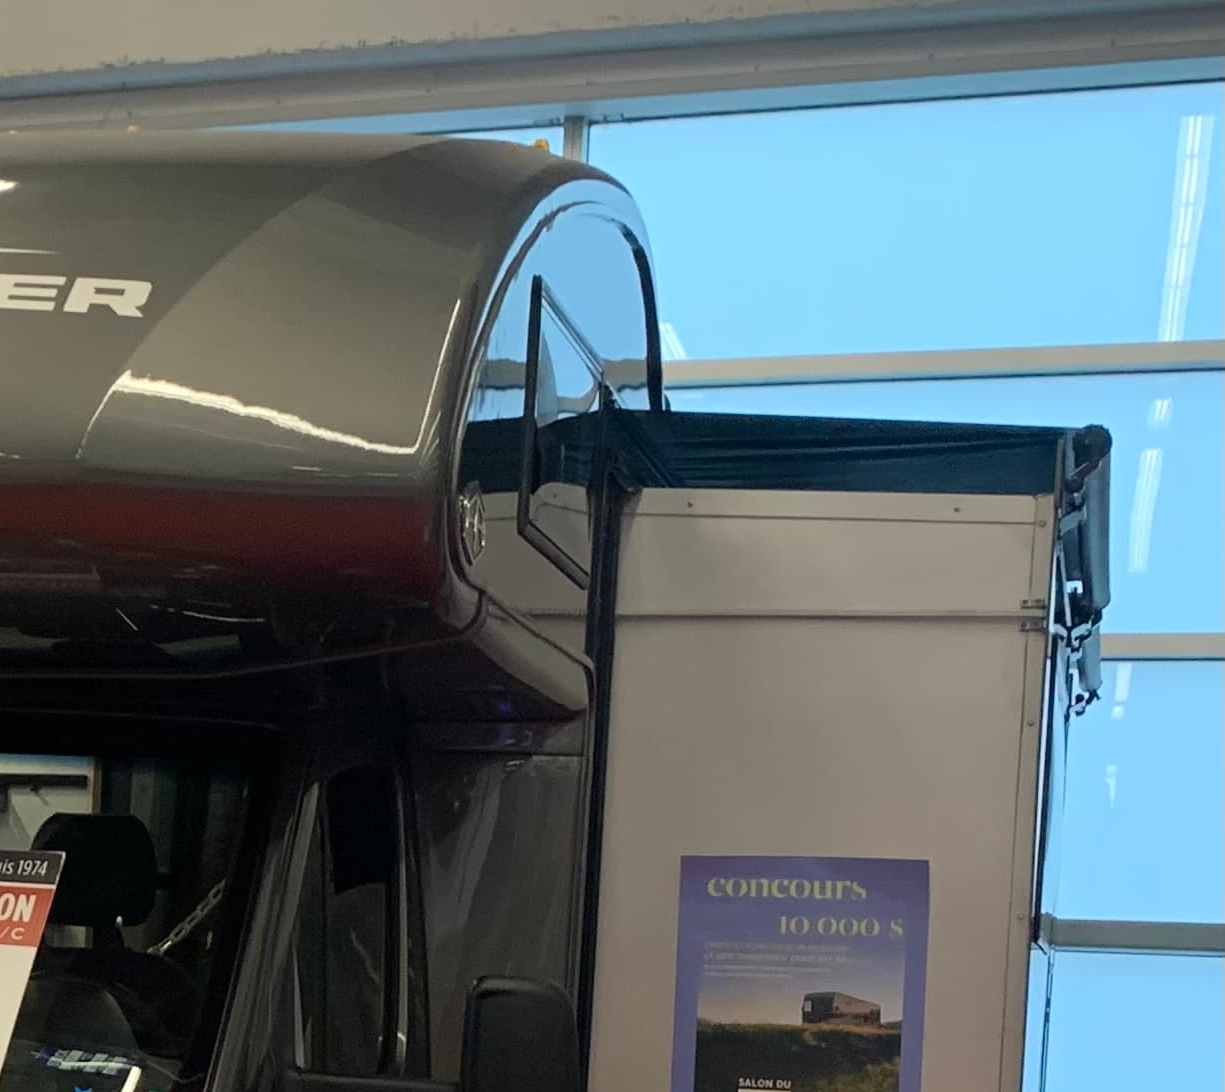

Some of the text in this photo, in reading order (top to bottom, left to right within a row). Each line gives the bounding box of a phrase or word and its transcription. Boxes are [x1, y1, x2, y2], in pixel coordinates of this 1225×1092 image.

[16, 860, 49, 876] 1974
[706, 876, 868, 900] concours
[779, 914, 810, 936] 10
[738, 1077, 792, 1090] SALON DU
